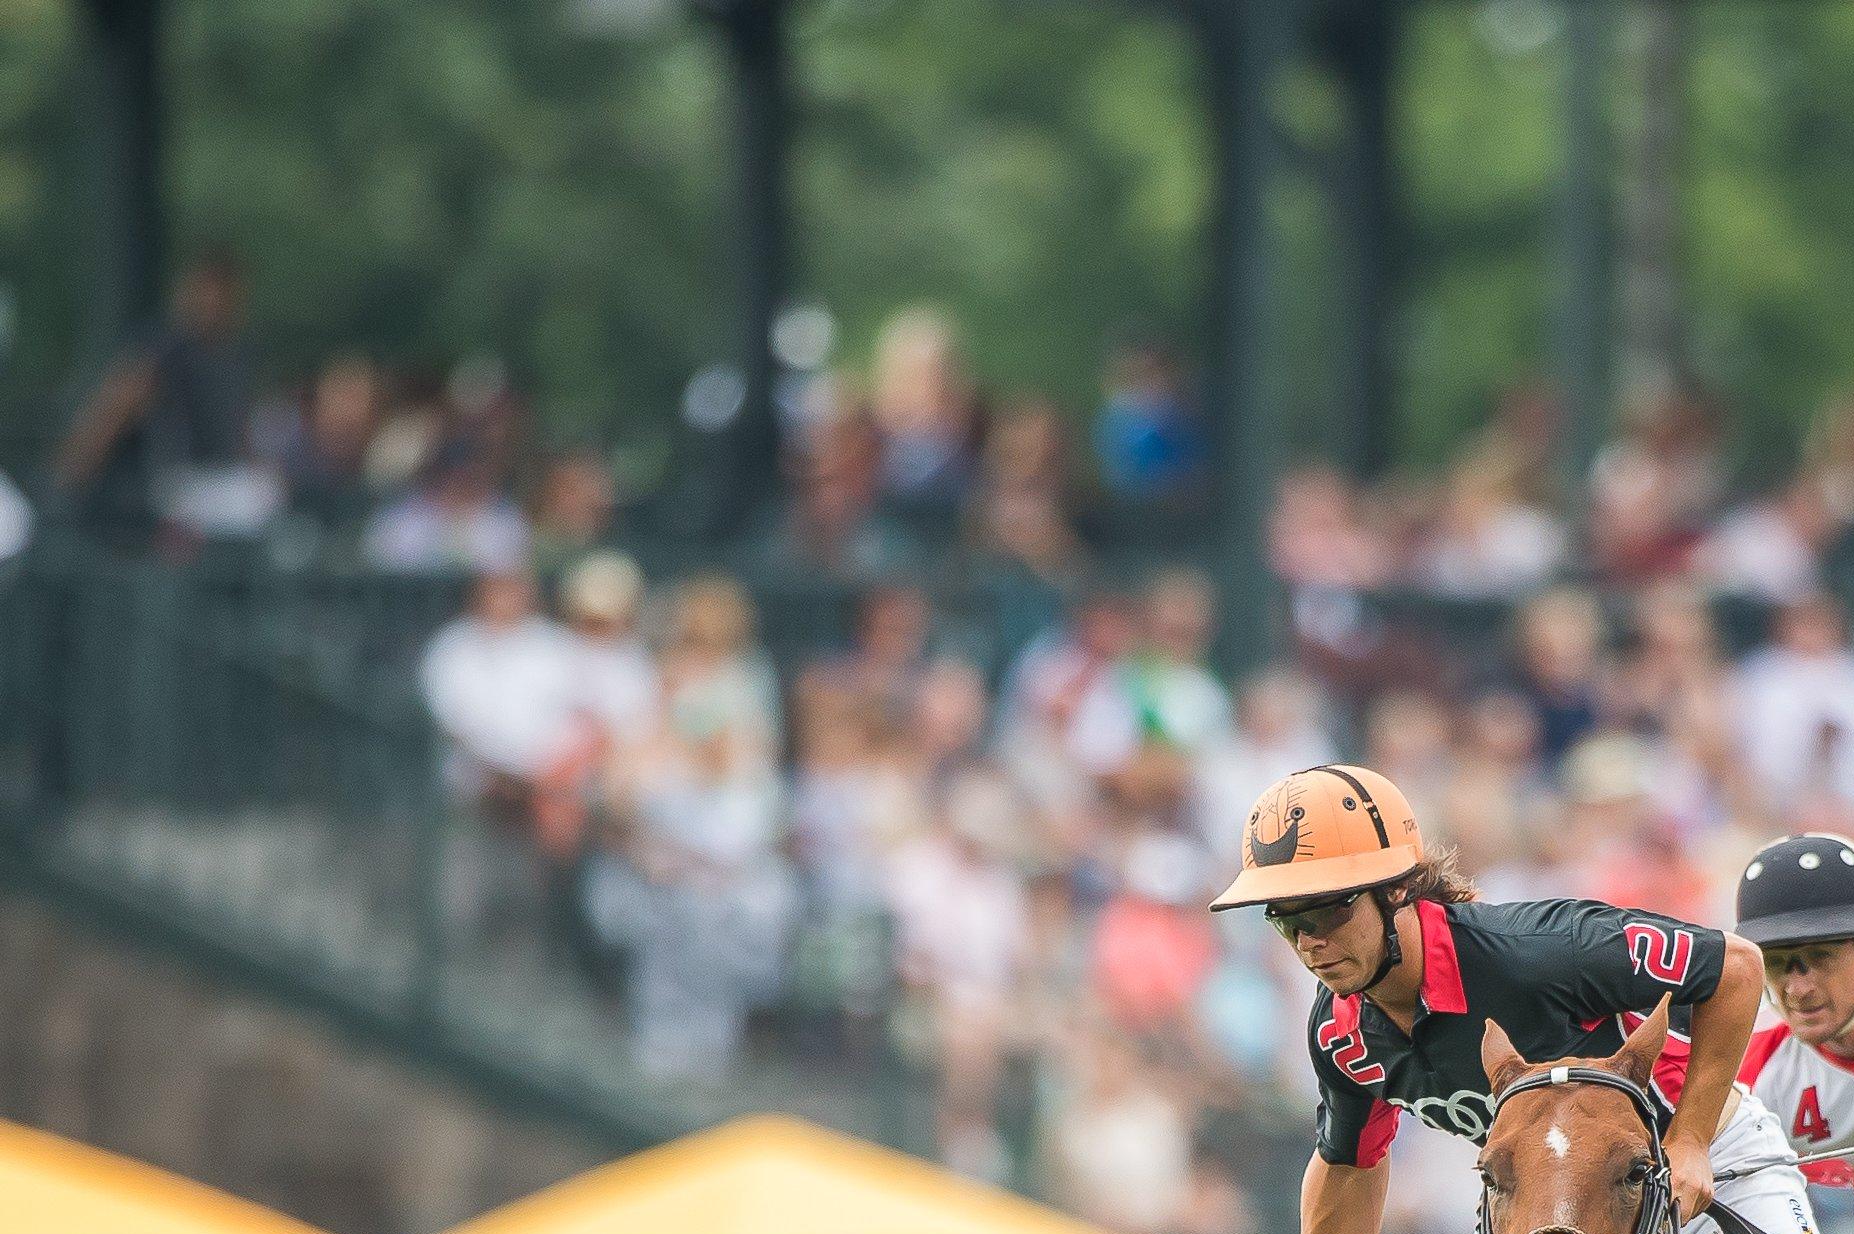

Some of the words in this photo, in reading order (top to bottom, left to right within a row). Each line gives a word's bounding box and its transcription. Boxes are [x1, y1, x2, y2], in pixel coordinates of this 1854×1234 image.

[1623, 922, 1694, 986] 2
[1318, 1018, 1386, 1085] 2
[1792, 1084, 1831, 1143] 4
